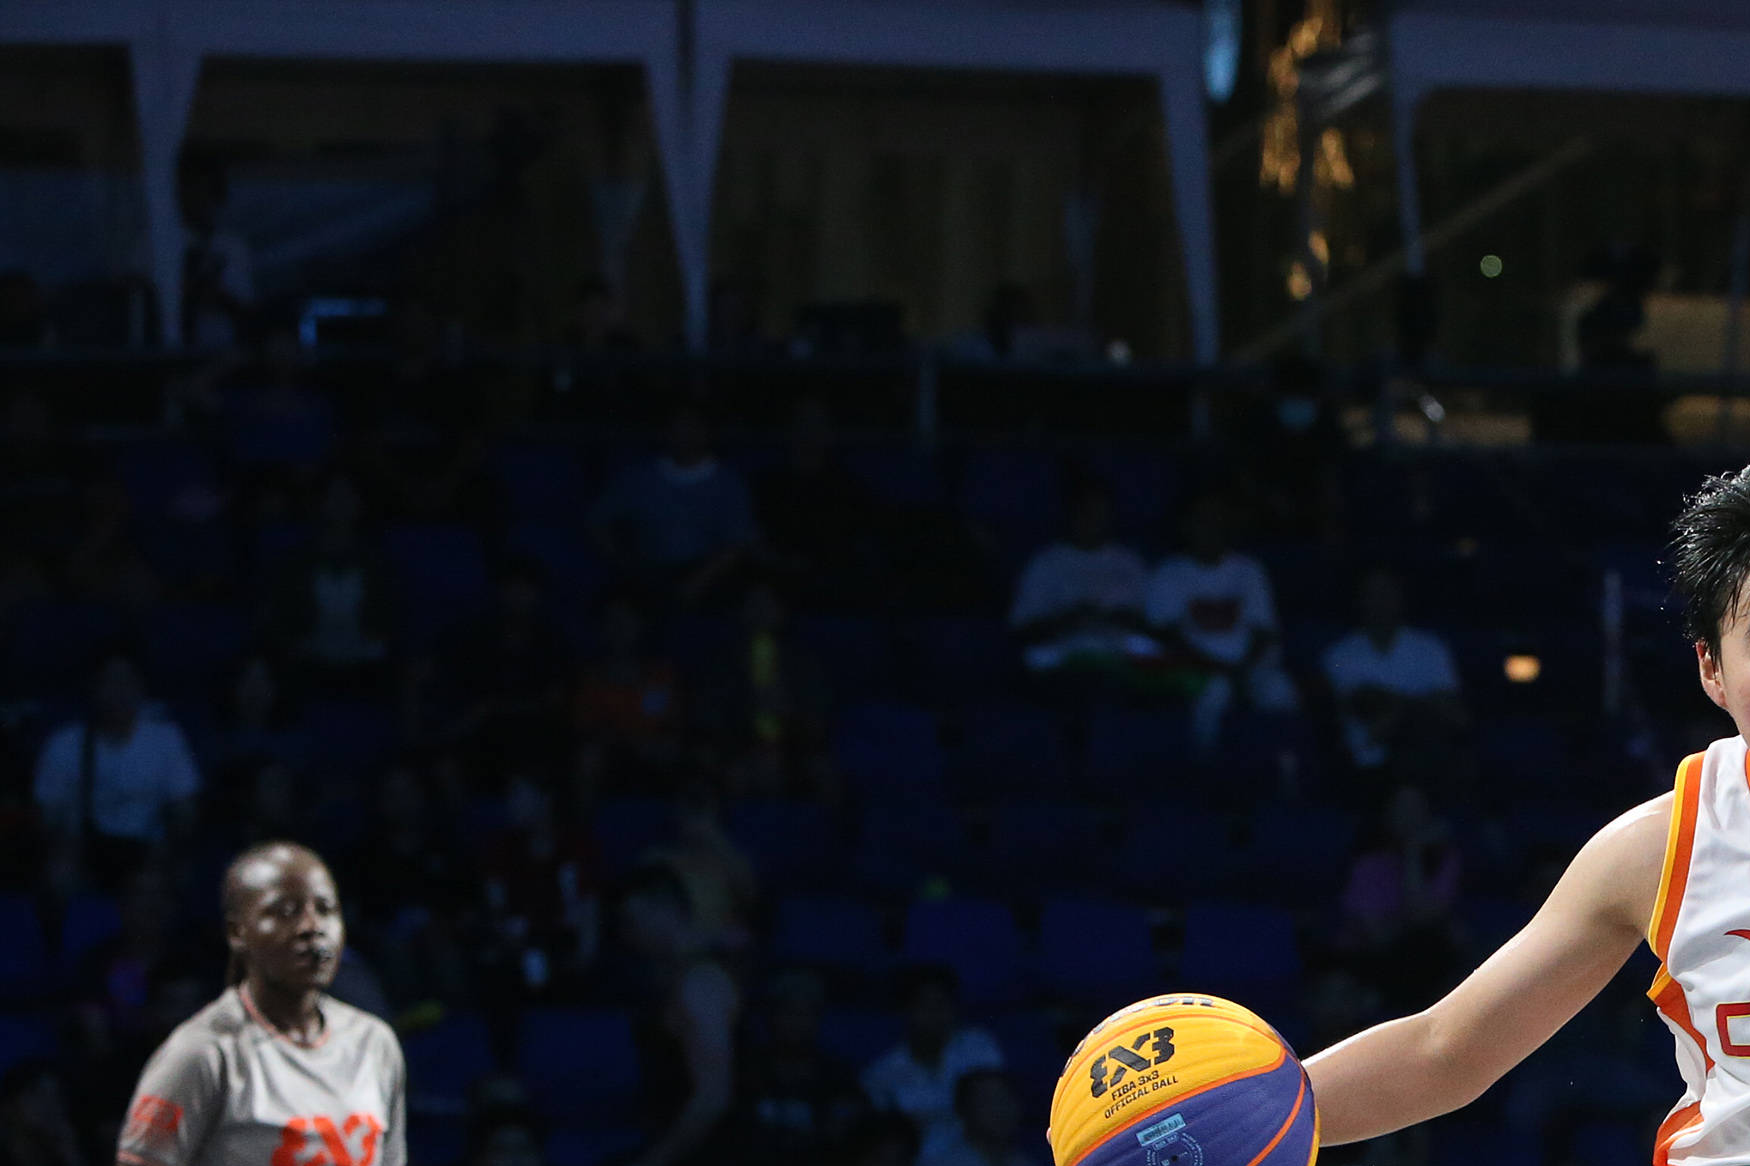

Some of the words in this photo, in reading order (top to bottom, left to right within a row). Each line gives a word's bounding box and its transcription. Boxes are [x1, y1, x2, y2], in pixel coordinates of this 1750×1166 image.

[1104, 1086, 1150, 1119] OFFICIAL
[1151, 1075, 1178, 1091] BALL
[1111, 1081, 1136, 1101] FIBA
